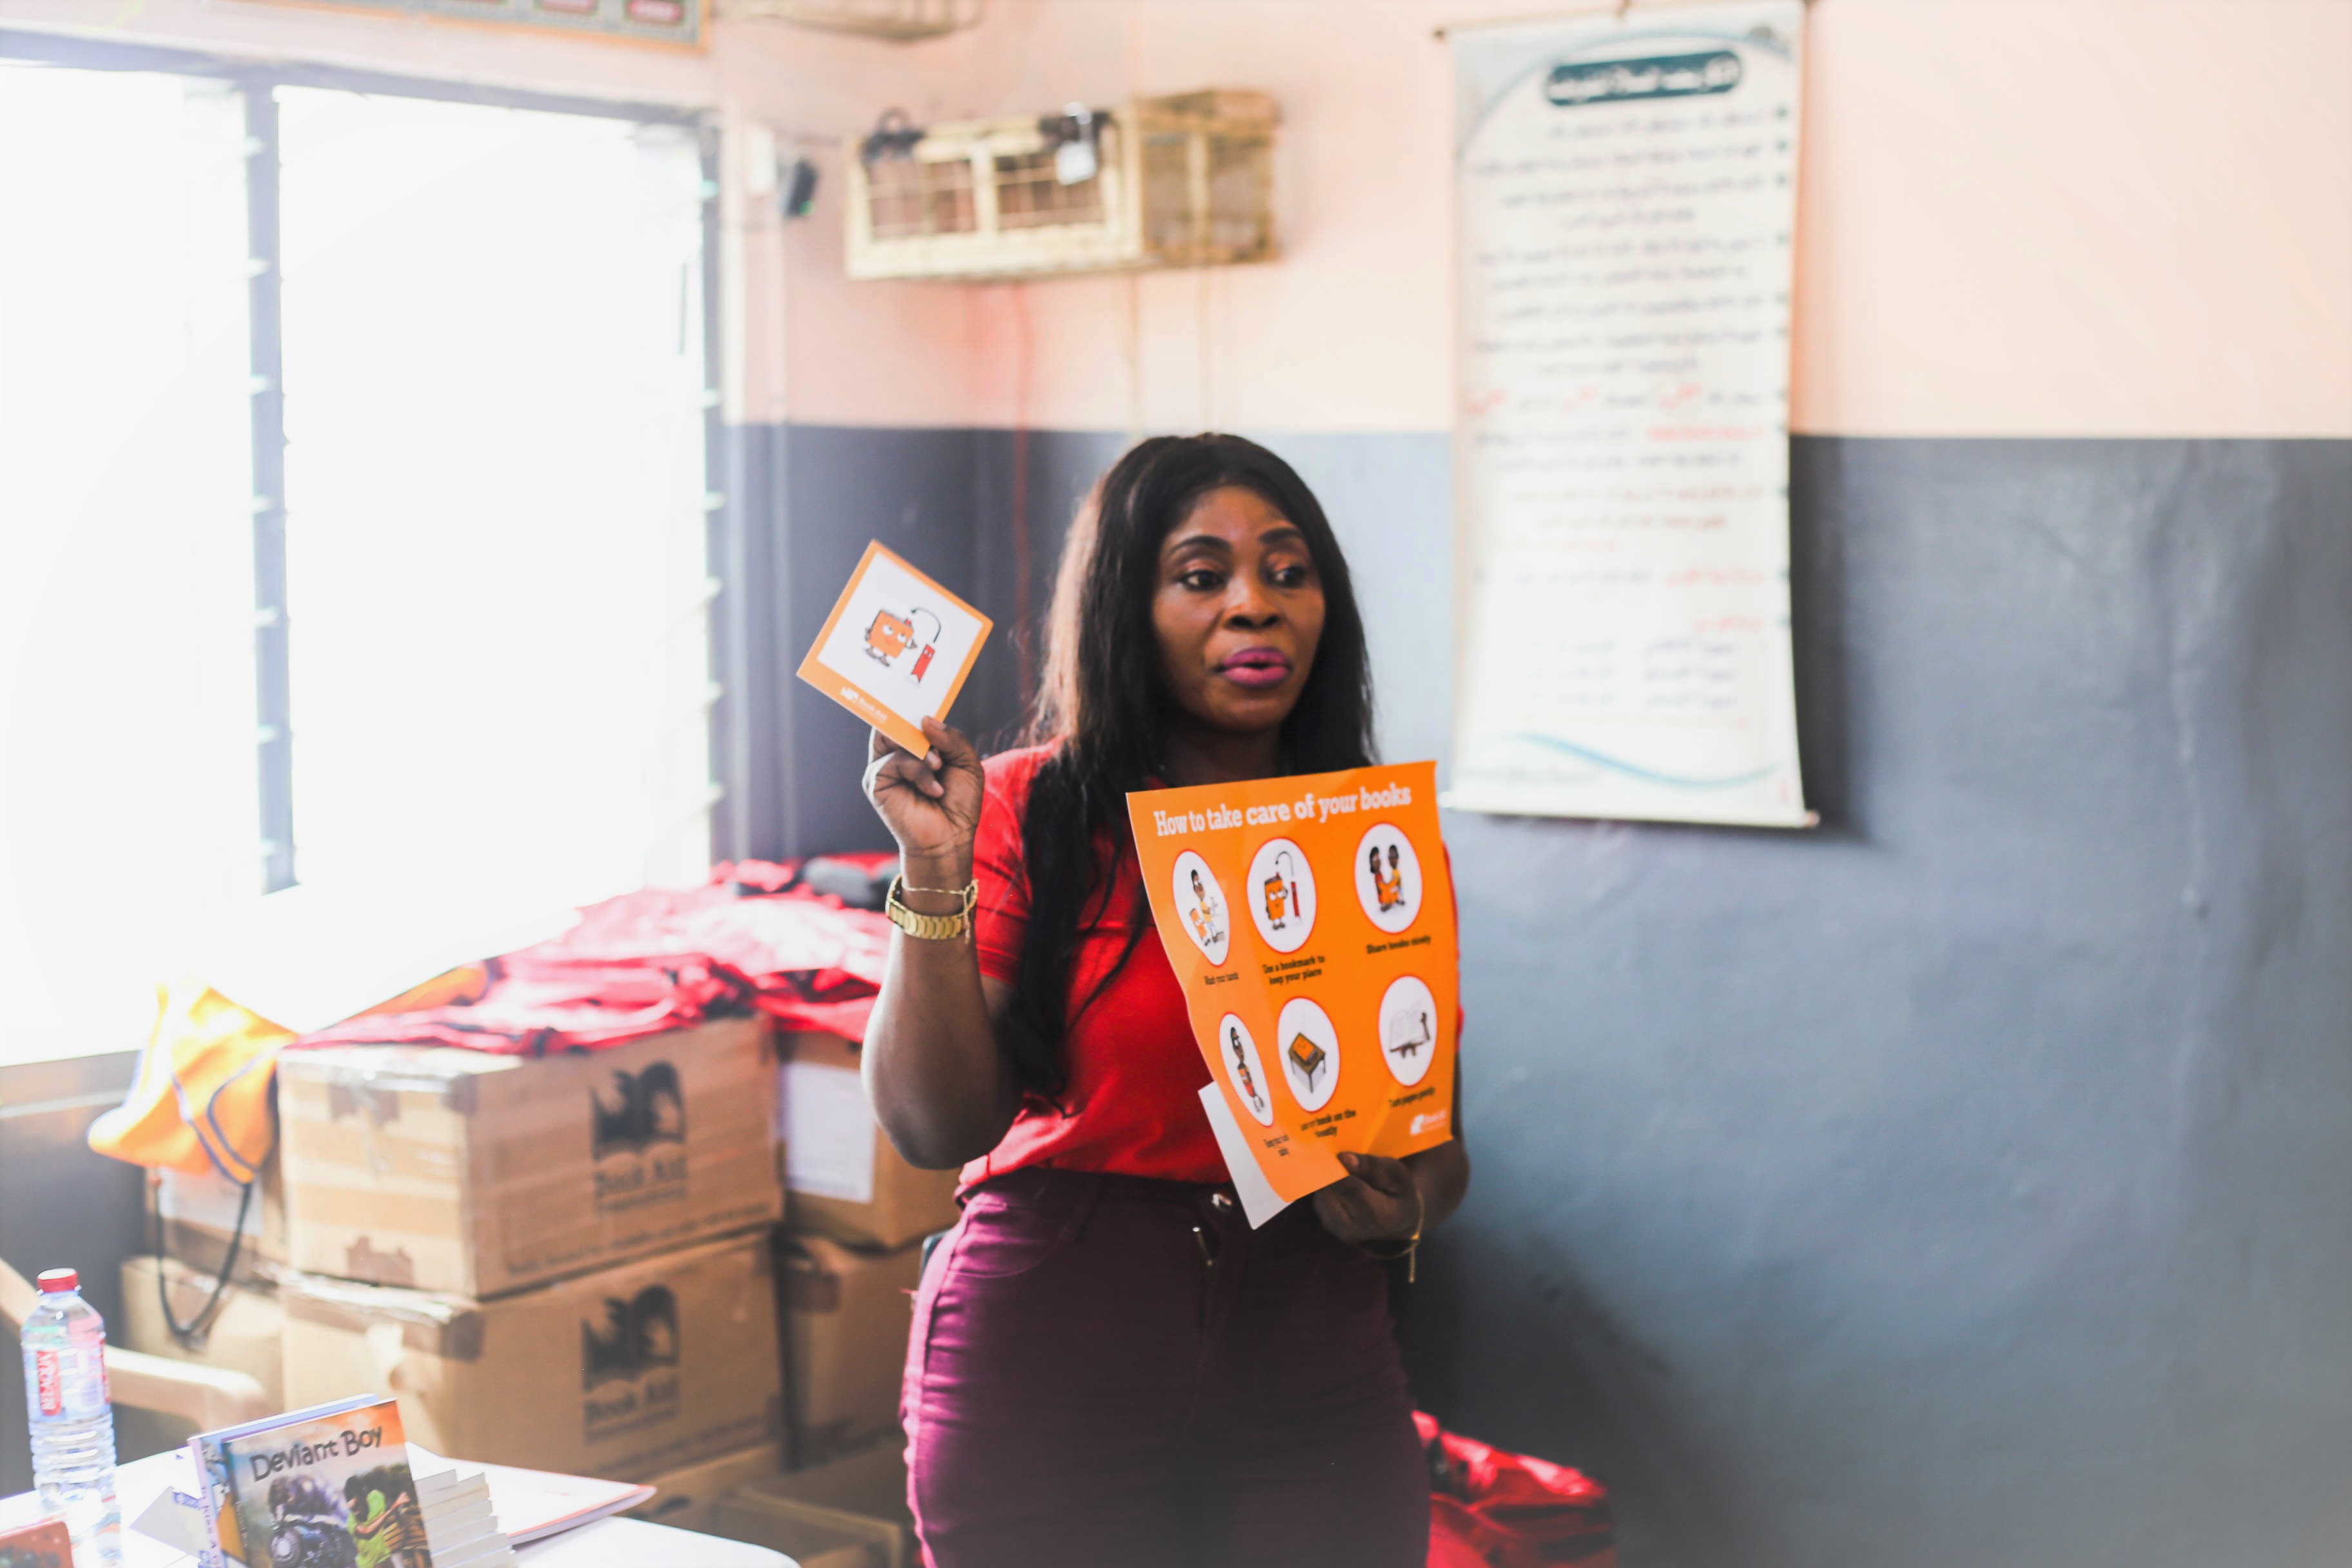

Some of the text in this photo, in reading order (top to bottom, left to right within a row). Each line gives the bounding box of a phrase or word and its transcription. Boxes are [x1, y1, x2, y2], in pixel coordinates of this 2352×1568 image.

[1153, 782, 1411, 836] How to take care of your books
[1280, 956, 1316, 970] bookmark
[1285, 972, 1301, 985] your
[249, 1426, 383, 1482] Deviant Boy
